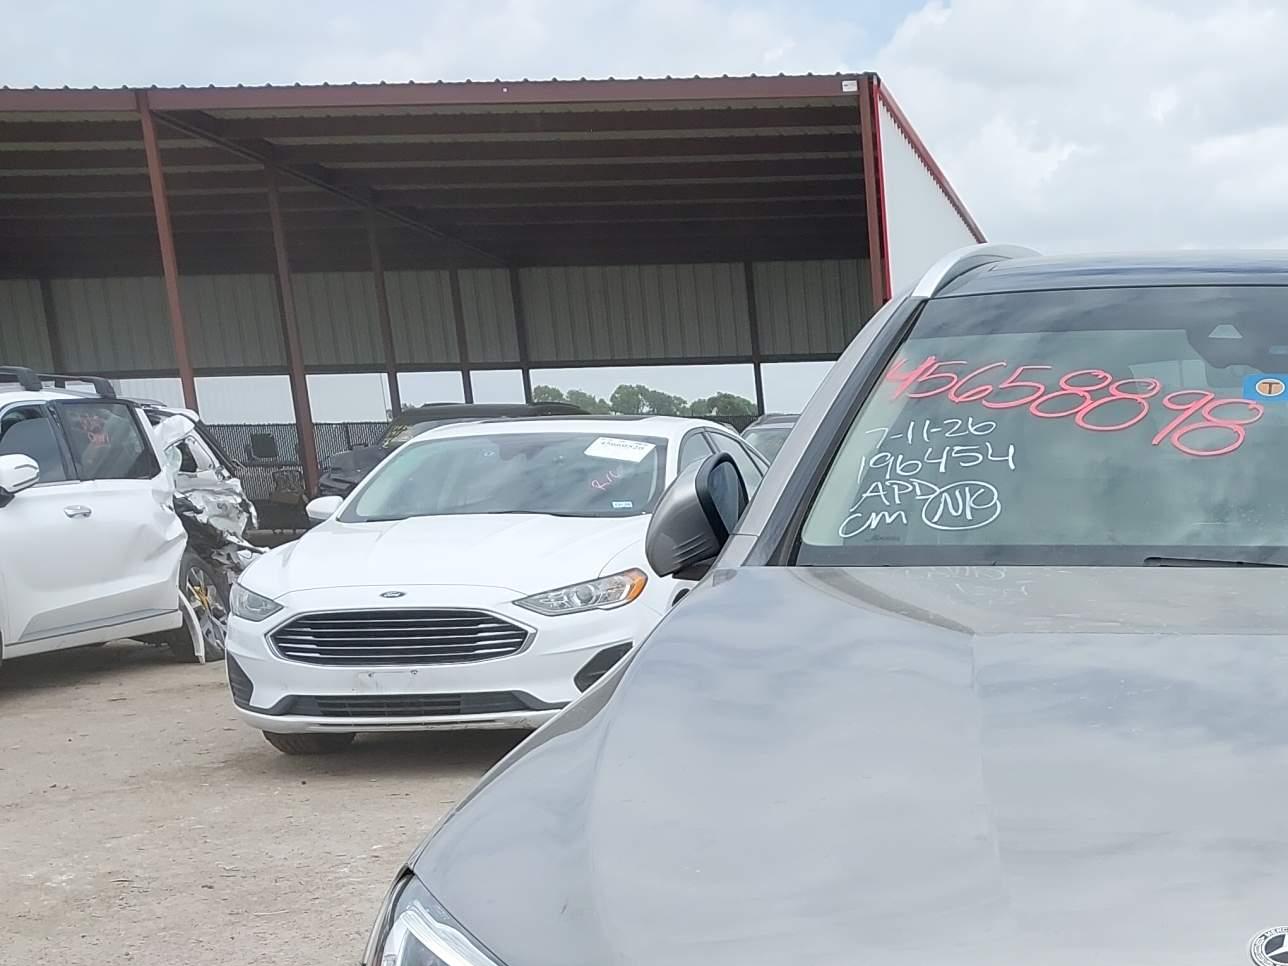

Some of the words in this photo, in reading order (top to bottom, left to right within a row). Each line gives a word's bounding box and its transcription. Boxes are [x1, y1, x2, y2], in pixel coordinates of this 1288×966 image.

[887, 356, 1264, 457] 45658898
[865, 417, 996, 448] 7-11-26
[857, 442, 1016, 483] 196454
[850, 478, 940, 512] APD
